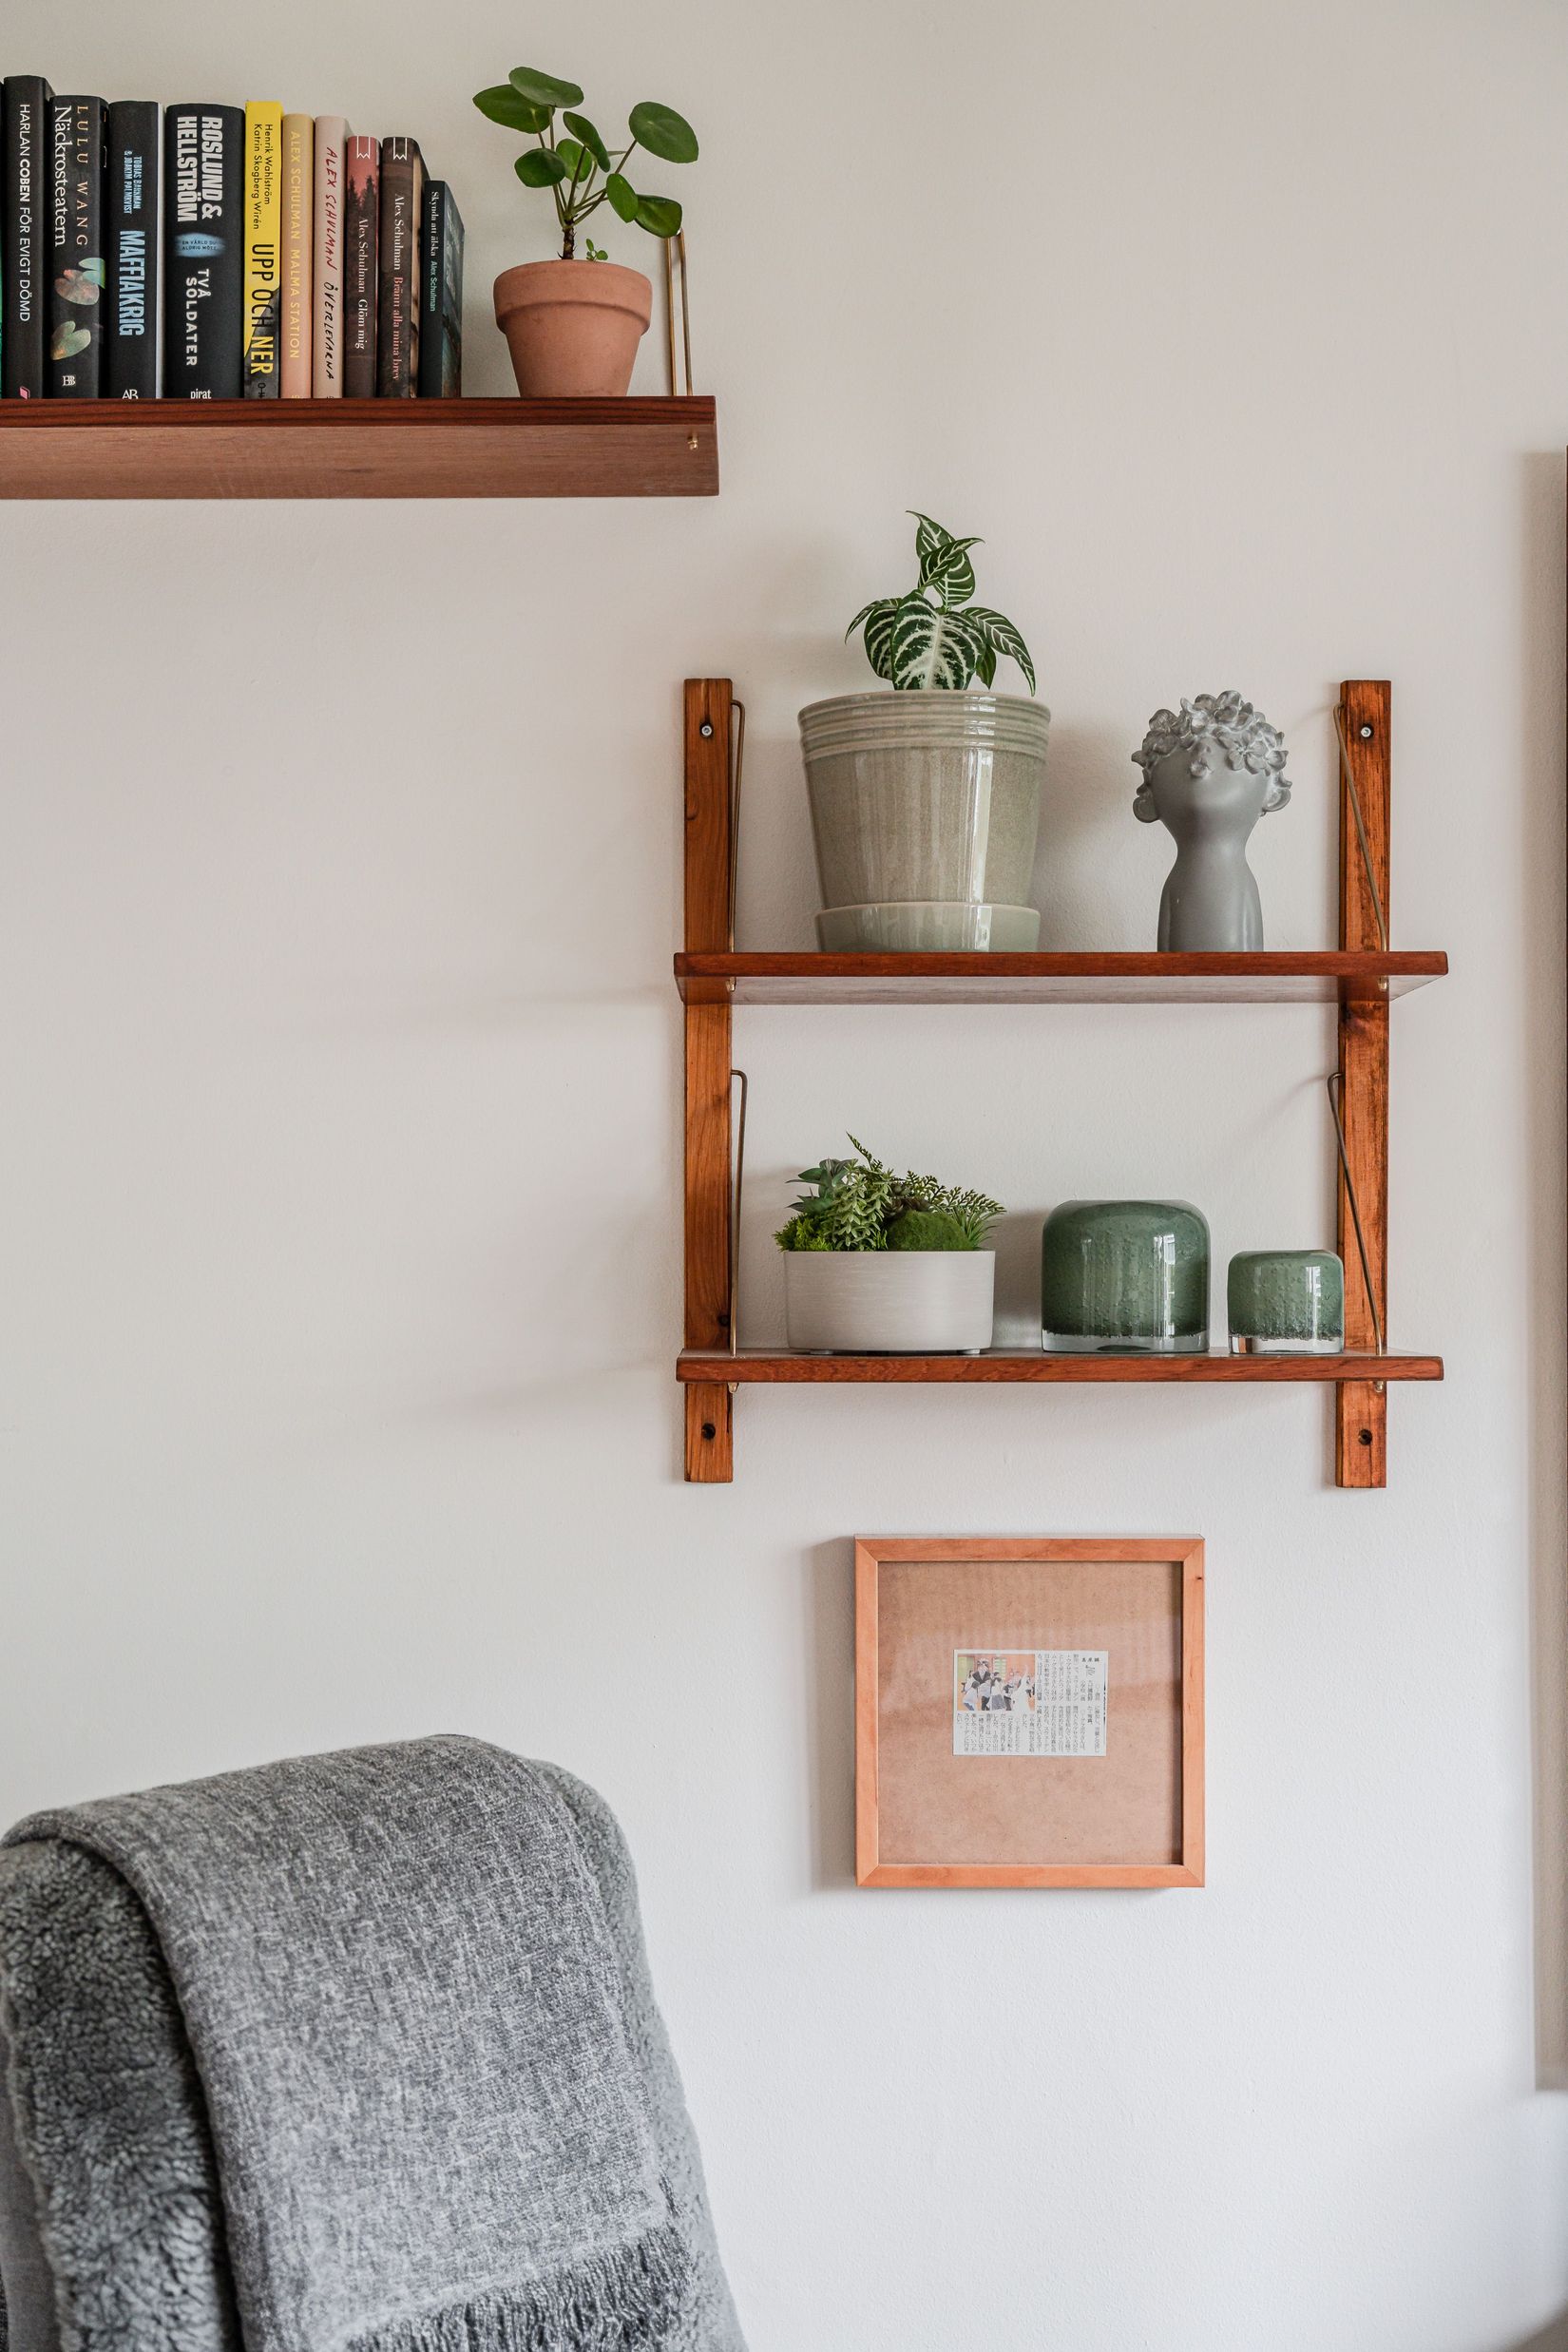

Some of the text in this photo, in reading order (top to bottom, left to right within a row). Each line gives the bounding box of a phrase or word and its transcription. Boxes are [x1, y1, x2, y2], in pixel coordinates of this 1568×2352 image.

[54, 105, 73, 248] Näckrosteatern
[76, 105, 88, 246] LULU WANG
[124, 157, 133, 180] JOAKIM
[133, 156, 143, 179] TOBIAS
[177, 116, 201, 222] HELLSTRÖM
[201, 116, 223, 220] ROSLUND &
[252, 124, 262, 230] Katrin Skogberg Wirén
[264, 124, 274, 205] Henrik Wahlström
[325, 146, 338, 188] ALEX
[19, 104, 32, 322] HARLAN COBEN FÖR EVIGT DÖMD
[124, 181, 133, 215] PALMKVIST
[394, 193, 405, 217] Alex
[429, 191, 439, 220] Skynda
[289, 131, 301, 358] ALEX SCHULMAN MALMA STATION
[325, 194, 338, 271] SCHULMAN
[393, 219, 404, 270] Schulman
[430, 236, 439, 257] älska
[119, 230, 145, 336] MAFFIAKRIG
[198, 268, 212, 298] TVÅ
[354, 217, 369, 350] Alex Schulman Glöm mig
[393, 277, 403, 307] Bränn
[430, 260, 438, 276] Alex
[250, 244, 275, 374] UPP OCH NER
[392, 310, 403, 328] alla
[430, 277, 438, 312] Schulman
[185, 277, 198, 366] SOLDATER
[323, 281, 338, 380] ÖVERLEVARNA
[392, 330, 403, 355] mina
[190, 388, 212, 399] pirat
